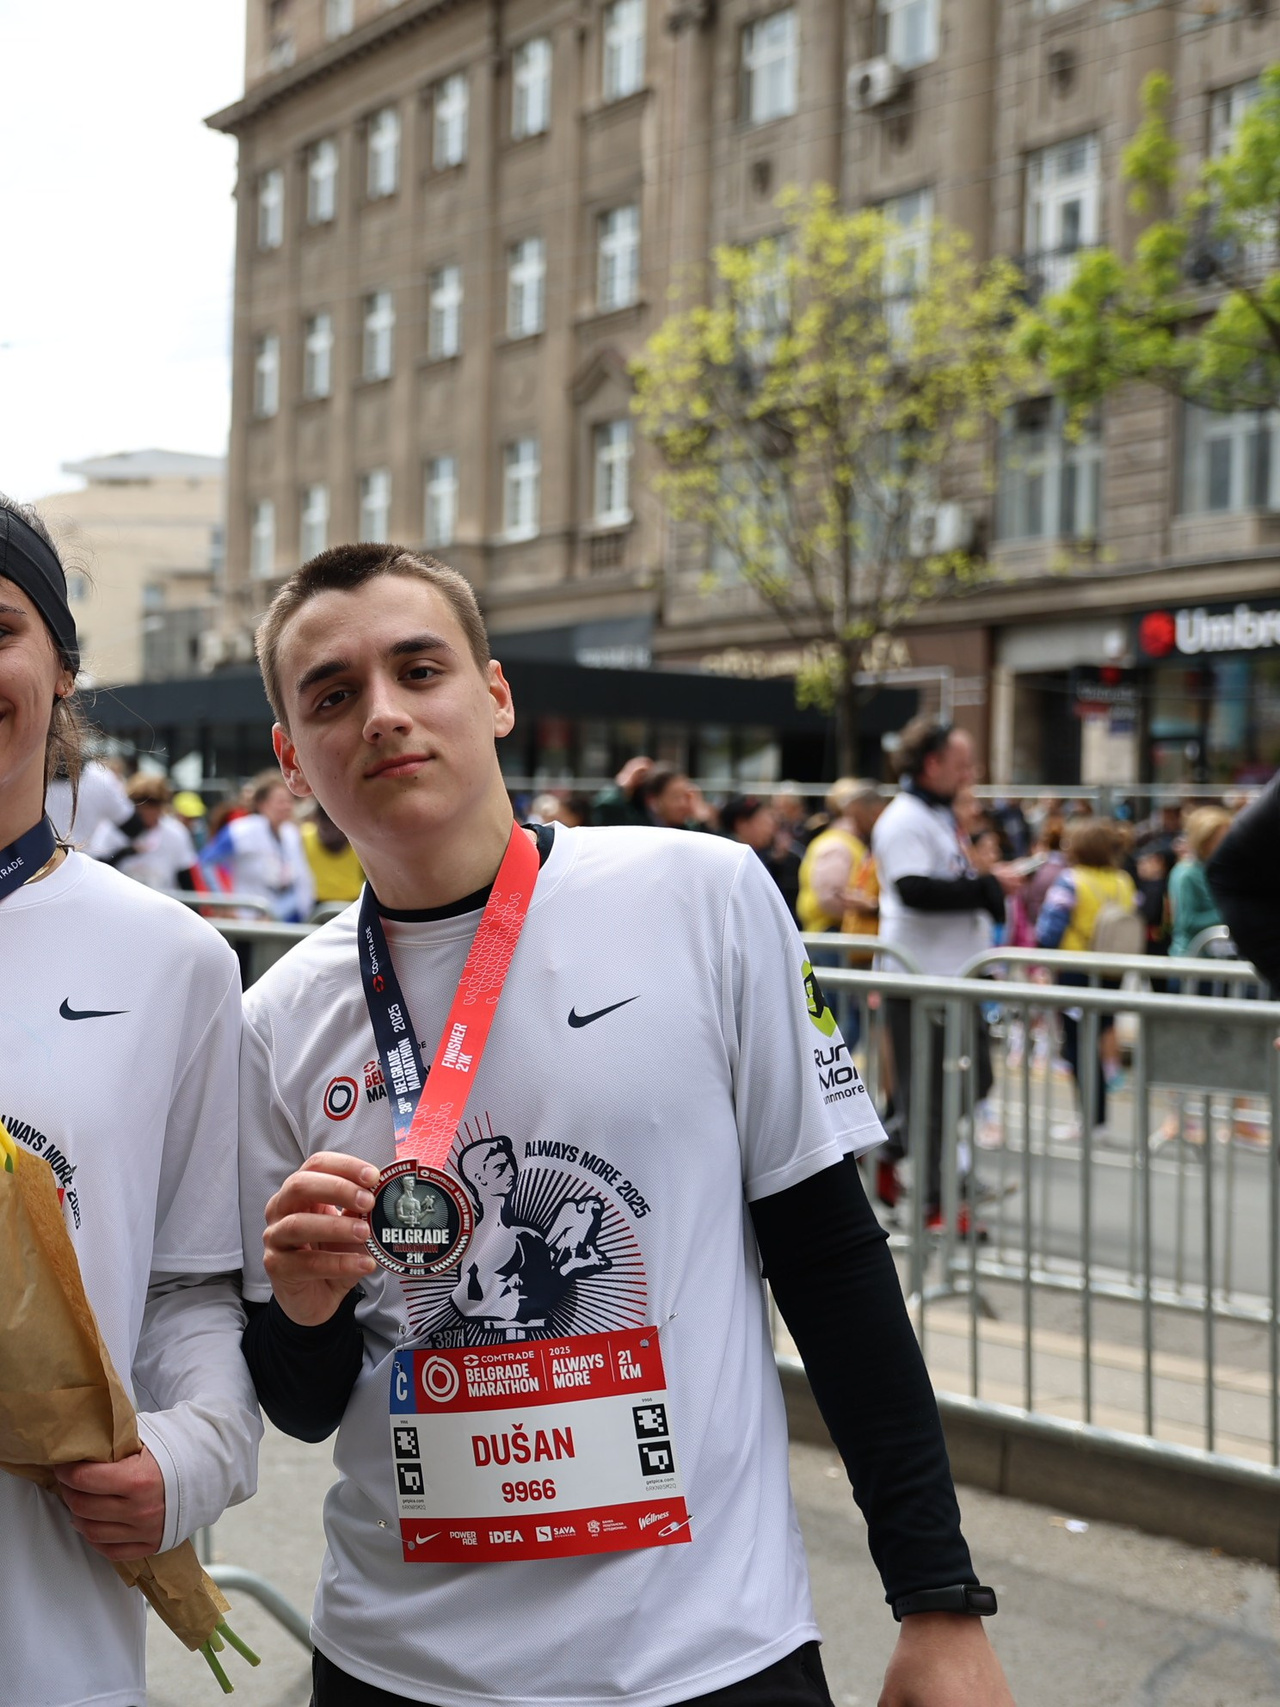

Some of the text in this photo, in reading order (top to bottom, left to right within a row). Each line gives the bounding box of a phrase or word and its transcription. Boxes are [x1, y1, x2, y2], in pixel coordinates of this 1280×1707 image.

[1175, 604, 1280, 654] Umbr
[365, 926, 379, 975] COMTRADE
[388, 1003, 406, 1033] 2025
[441, 1022, 468, 1069] FINISHER
[387, 1047, 409, 1095] BELGRADE
[398, 1037, 421, 1091] MARATHON
[455, 1054, 473, 1073] 21K
[42, 1144, 73, 1188] MORE
[525, 1140, 651, 1219] ALWAYS MORE 2025
[382, 1228, 449, 1244] BELGRADE
[406, 1253, 425, 1263] 21K
[432, 1329, 465, 1349] 38TH
[481, 1350, 535, 1363] COMTRADE
[548, 1346, 571, 1356] 2025
[617, 1350, 632, 1365] 21
[465, 1363, 530, 1382] BELGRADE
[552, 1354, 604, 1374] ALWAYS
[620, 1364, 642, 1380] KM
[396, 1371, 408, 1400] C
[466, 1377, 540, 1397] MARATHON
[553, 1371, 591, 1389] MORE
[471, 1423, 576, 1467] DUŠAN
[501, 1478, 557, 1503] 9966
[646, 1477, 674, 1485] getpica.com
[553, 1526, 576, 1535] SAVA
[638, 1511, 669, 1530] Wellness
[449, 1531, 476, 1539] POWER
